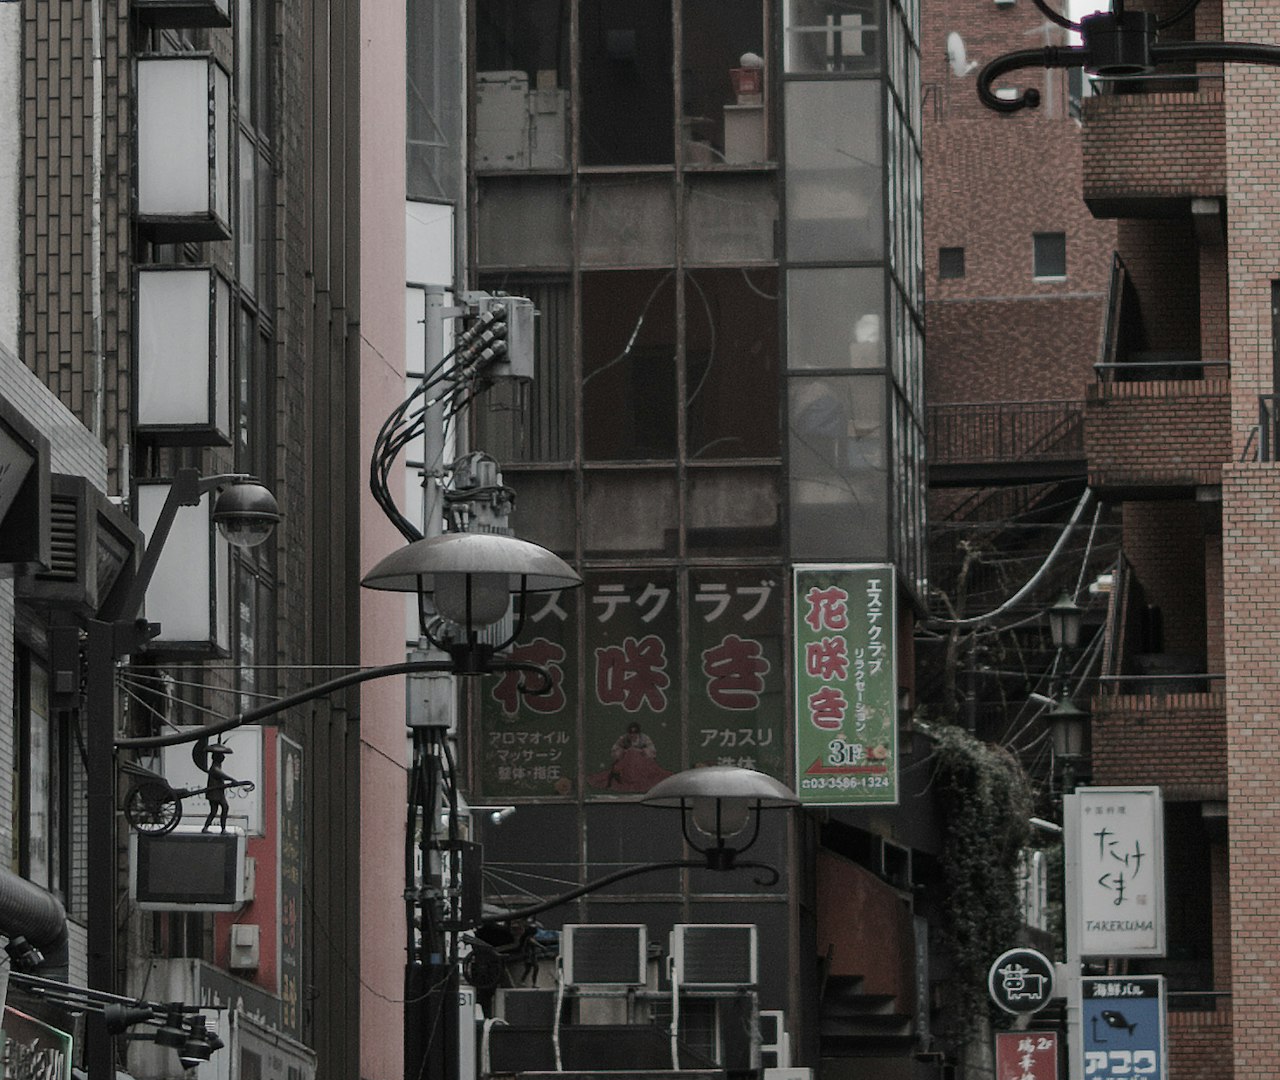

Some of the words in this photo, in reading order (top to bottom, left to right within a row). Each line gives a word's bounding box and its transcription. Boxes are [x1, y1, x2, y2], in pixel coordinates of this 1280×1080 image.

[515, 580, 775, 623] ステクラブ
[865, 579, 883, 676] エステクラブ
[804, 585, 850, 732] 花咲き
[854, 648, 866, 734] リラクゼーション
[489, 730, 570, 746] アロマオイル
[699, 728, 773, 747] アカスリ
[497, 748, 562, 762] マッサージ
[828, 740, 862, 765] 3F
[1085, 920, 1154, 932] TAKEKUMA
